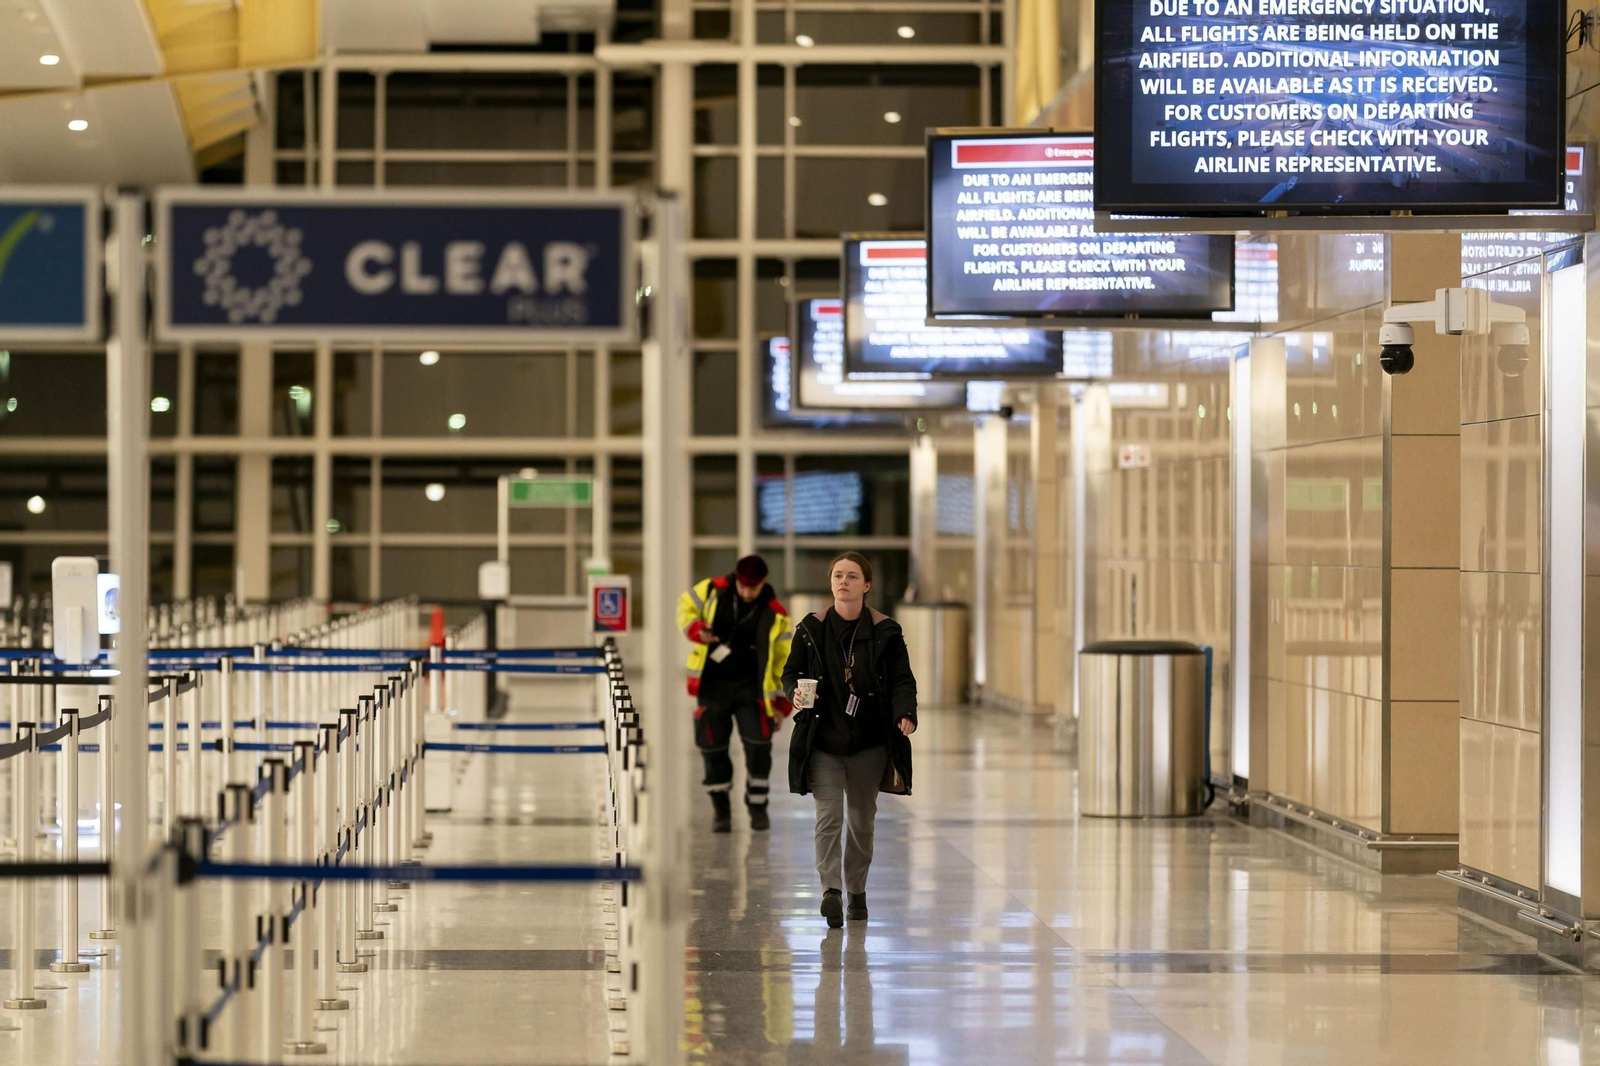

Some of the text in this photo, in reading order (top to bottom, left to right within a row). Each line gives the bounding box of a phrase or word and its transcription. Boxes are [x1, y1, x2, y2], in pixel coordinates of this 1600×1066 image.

[1151, 0, 1489, 17] DUE TO AN EMERGENCY SITUATION,
[1141, 24, 1498, 42] ALL FLIGHTS ARE BEING HELD ON THE
[1139, 50, 1498, 68] AIRFIELD. ADDITIONAL INFORMATION
[1141, 77, 1497, 94] WILL BE AVAILABLE AS IT IS RECEIVED.
[1165, 103, 1473, 120] FOR CUSTOMERS ON DEPARTING
[1151, 129, 1488, 148] FLIGHTS, PLEASE CHECK WITH YOUR
[1195, 156, 1441, 172] AIRLINE REPRESENTATIVE.
[963, 173, 1093, 186] DUE TO AN EMERGEN
[957, 190, 1093, 204] ALL FLIGHTS ARE BEIN
[956, 209, 1016, 221] AIRFIELD.
[957, 227, 989, 239] WILL
[991, 226, 1007, 238] BE
[1009, 225, 1078, 238] AVAILABLE
[974, 241, 1175, 256] FOR CUSTOMERS ON DEPARTING
[344, 240, 590, 295] CLEAR
[964, 259, 1185, 274] FLIGHTS, PLEASE CHECK WITH YOUR
[993, 277, 1155, 291] AIRLINE REPRESENTATIVE.
